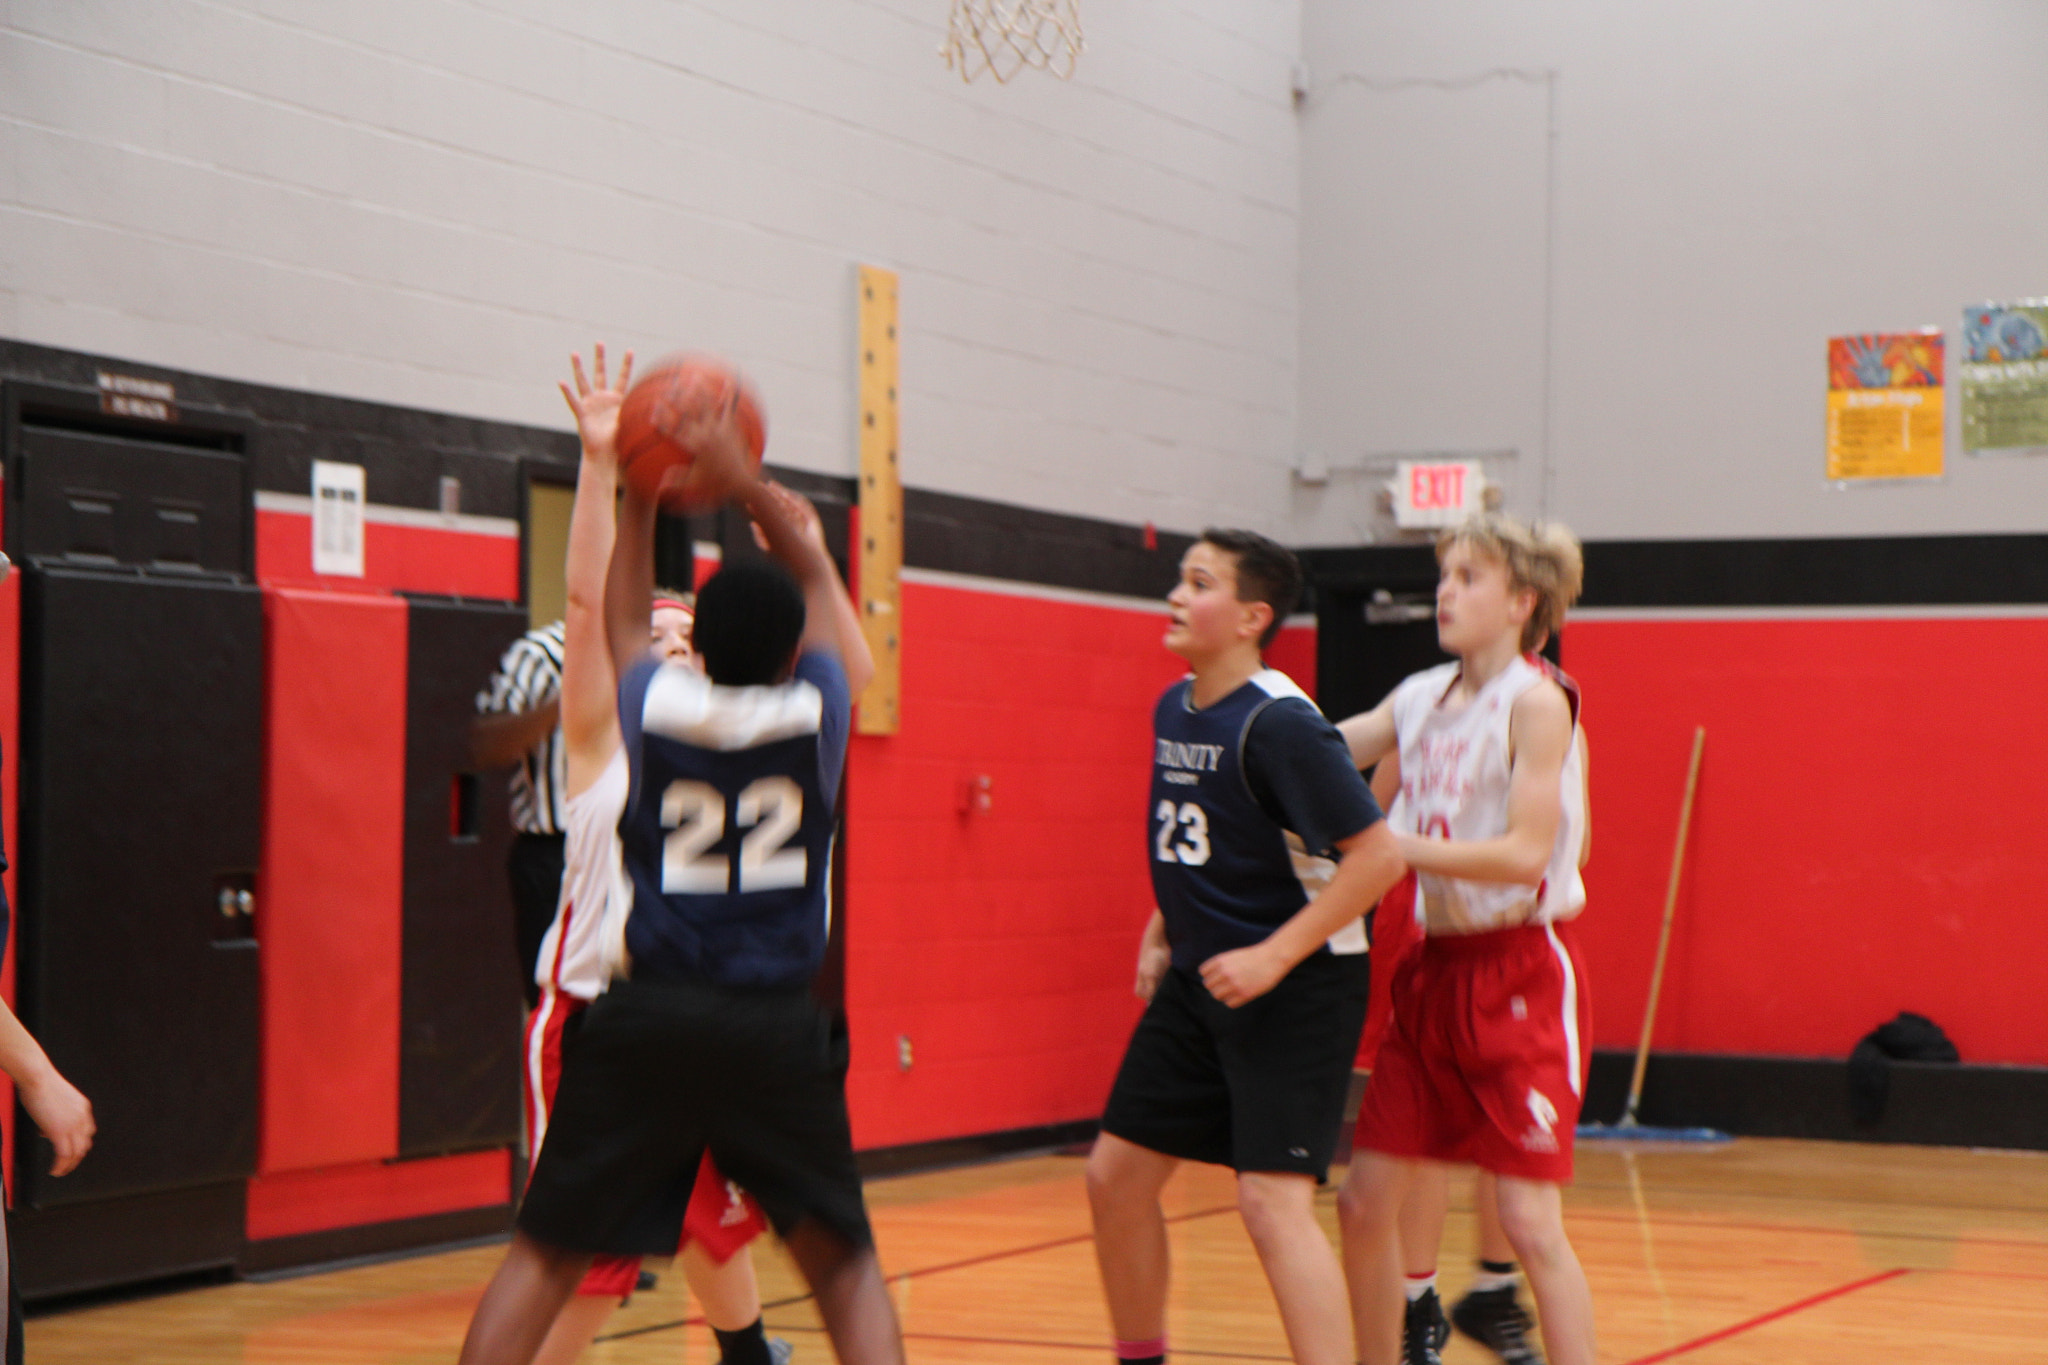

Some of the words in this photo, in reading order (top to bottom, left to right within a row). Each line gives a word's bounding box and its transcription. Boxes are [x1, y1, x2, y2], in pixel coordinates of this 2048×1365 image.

[1411, 464, 1469, 510] EXIT
[660, 775, 808, 895] 22
[1156, 800, 1211, 866] 23
